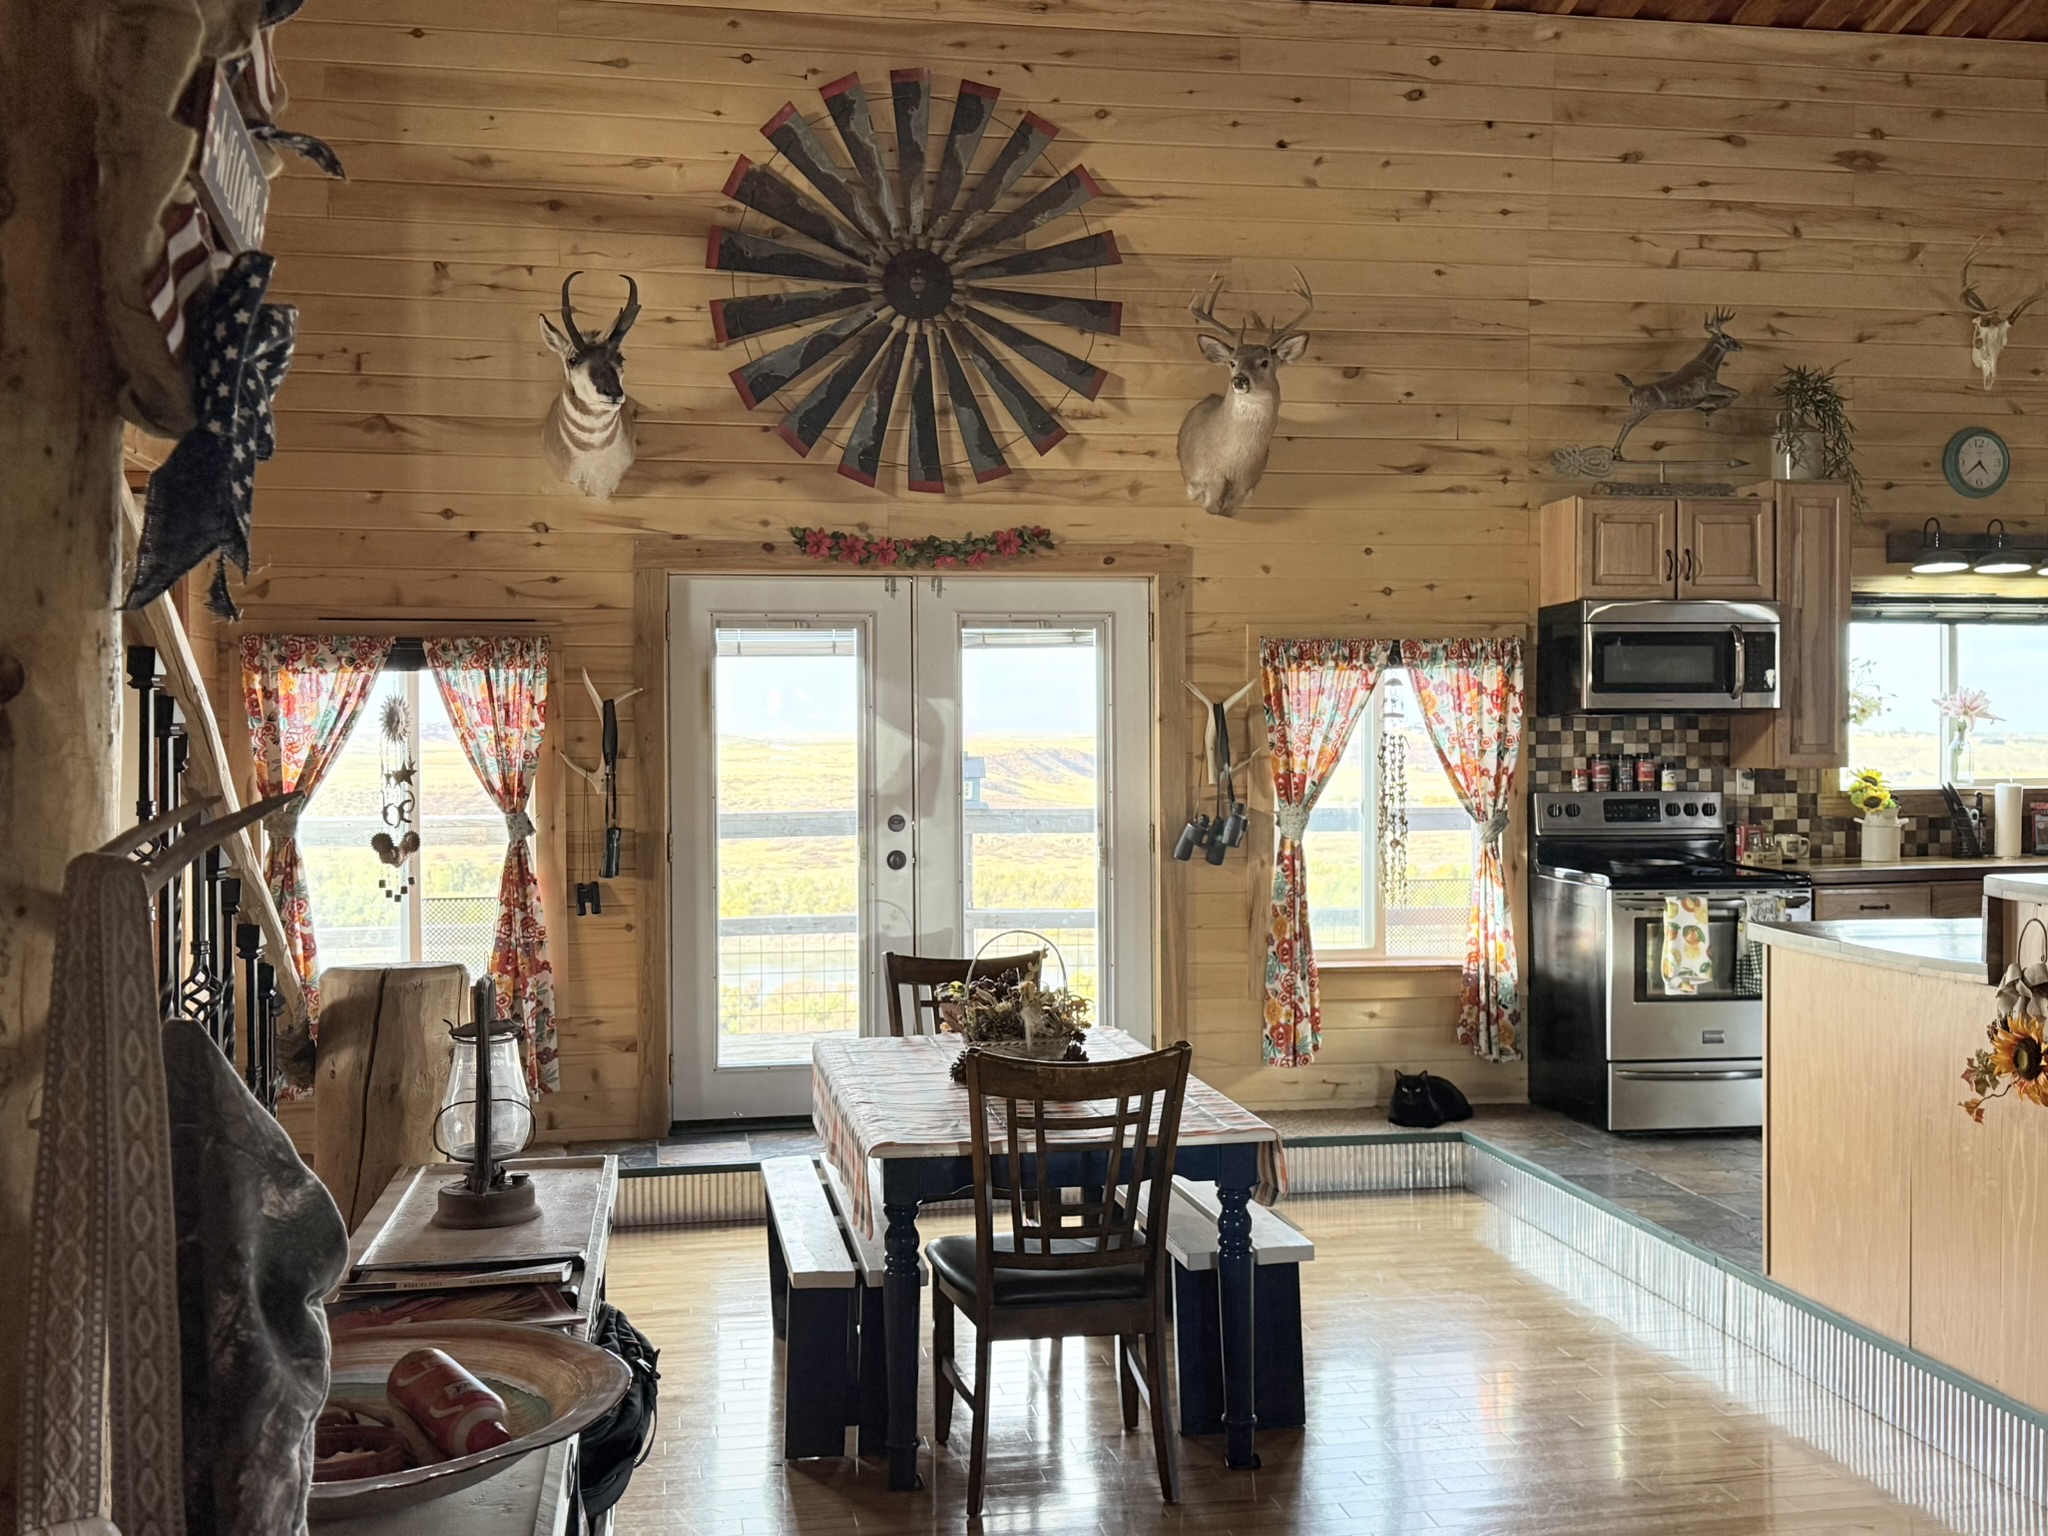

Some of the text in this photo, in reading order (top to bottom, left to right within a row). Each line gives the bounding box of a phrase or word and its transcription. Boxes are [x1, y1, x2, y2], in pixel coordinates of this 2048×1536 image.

[215, 109, 262, 247] WELCOME
[1974, 438, 1985, 448] 12
[1994, 458, 2001, 467] 3
[1975, 477, 1983, 487] 6
